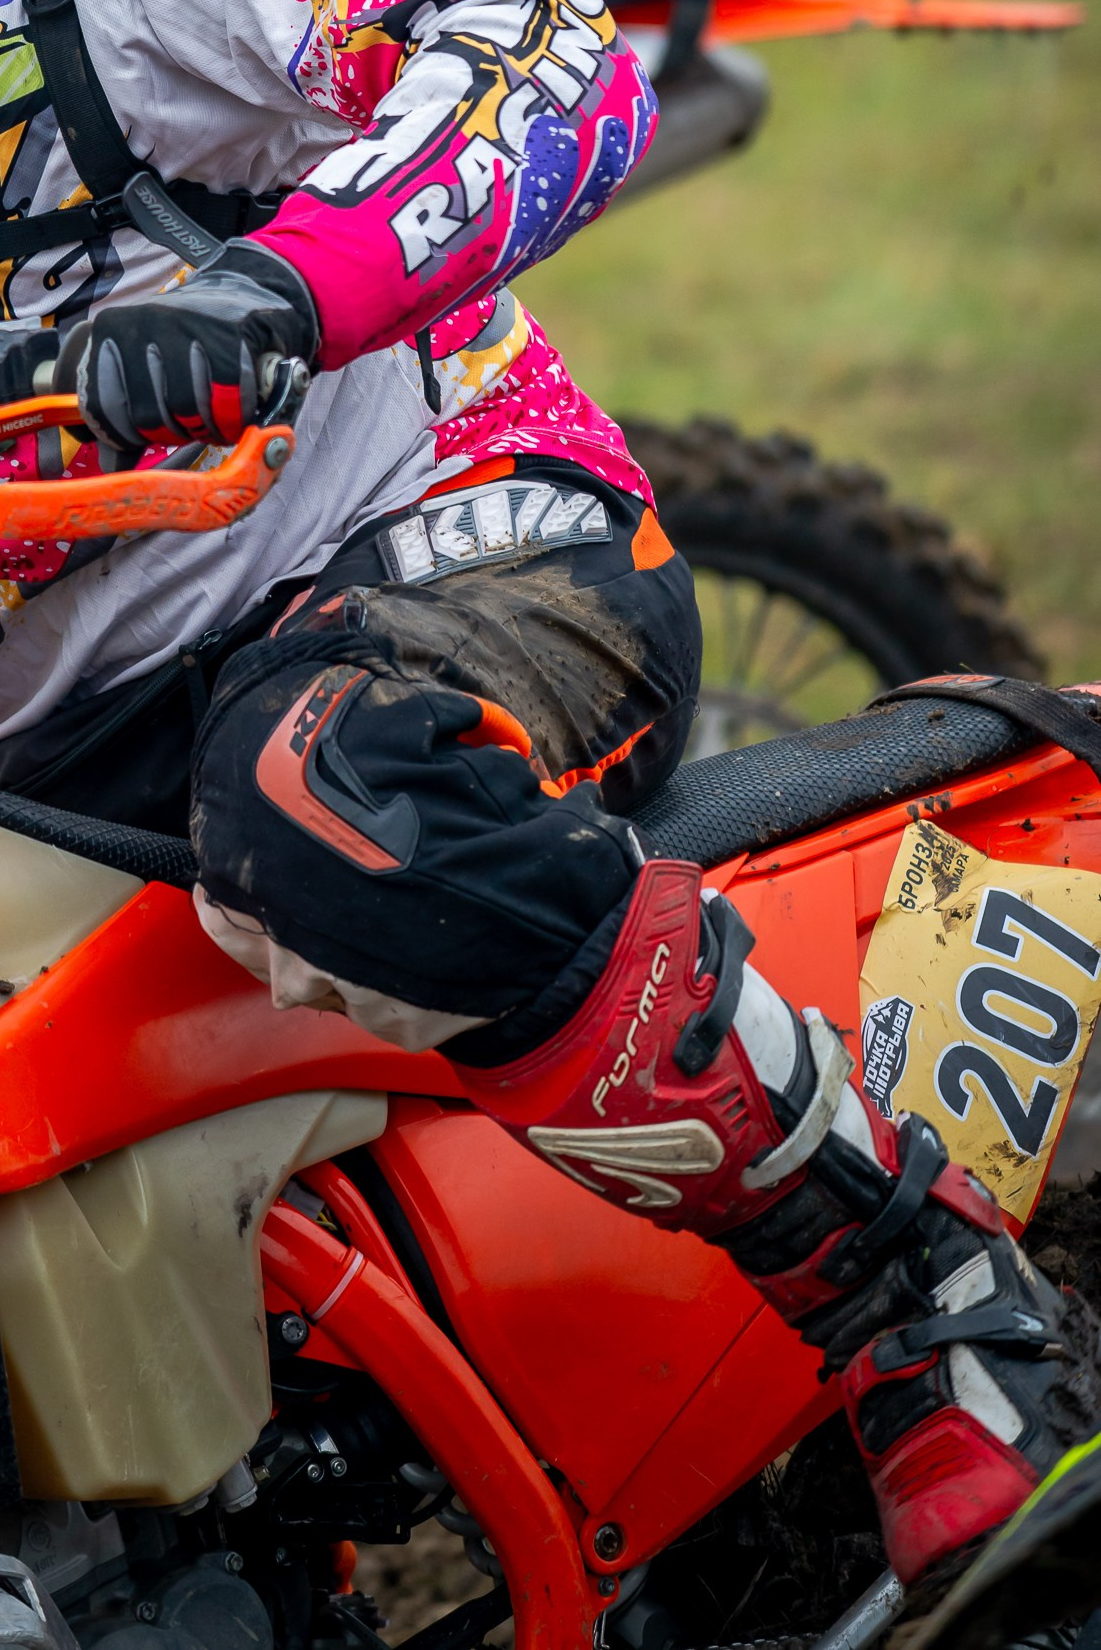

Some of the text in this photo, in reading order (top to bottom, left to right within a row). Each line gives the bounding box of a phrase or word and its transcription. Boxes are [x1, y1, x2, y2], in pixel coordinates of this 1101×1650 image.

[134, 186, 211, 257] FASTHOUSE
[2, 414, 44, 433] NICECNC
[935, 887, 1101, 1159] 207
[863, 1030, 888, 1089] ТОЧКА
